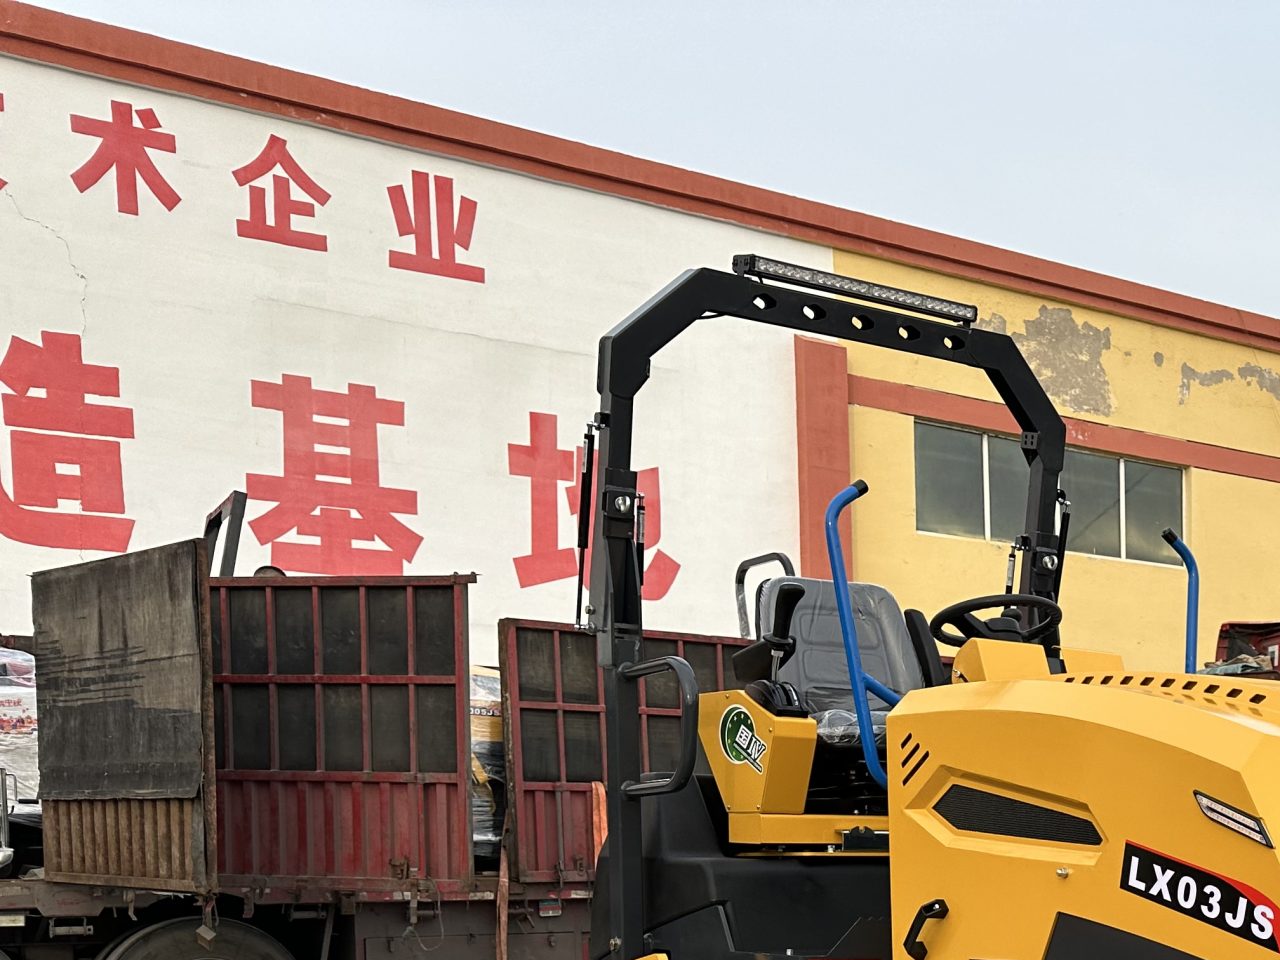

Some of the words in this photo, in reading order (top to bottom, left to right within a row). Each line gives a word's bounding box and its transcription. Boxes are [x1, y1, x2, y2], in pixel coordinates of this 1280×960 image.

[0, 92, 486, 284] 术企业
[0, 331, 681, 601] 造基地
[1128, 855, 1274, 940] LX03JS
